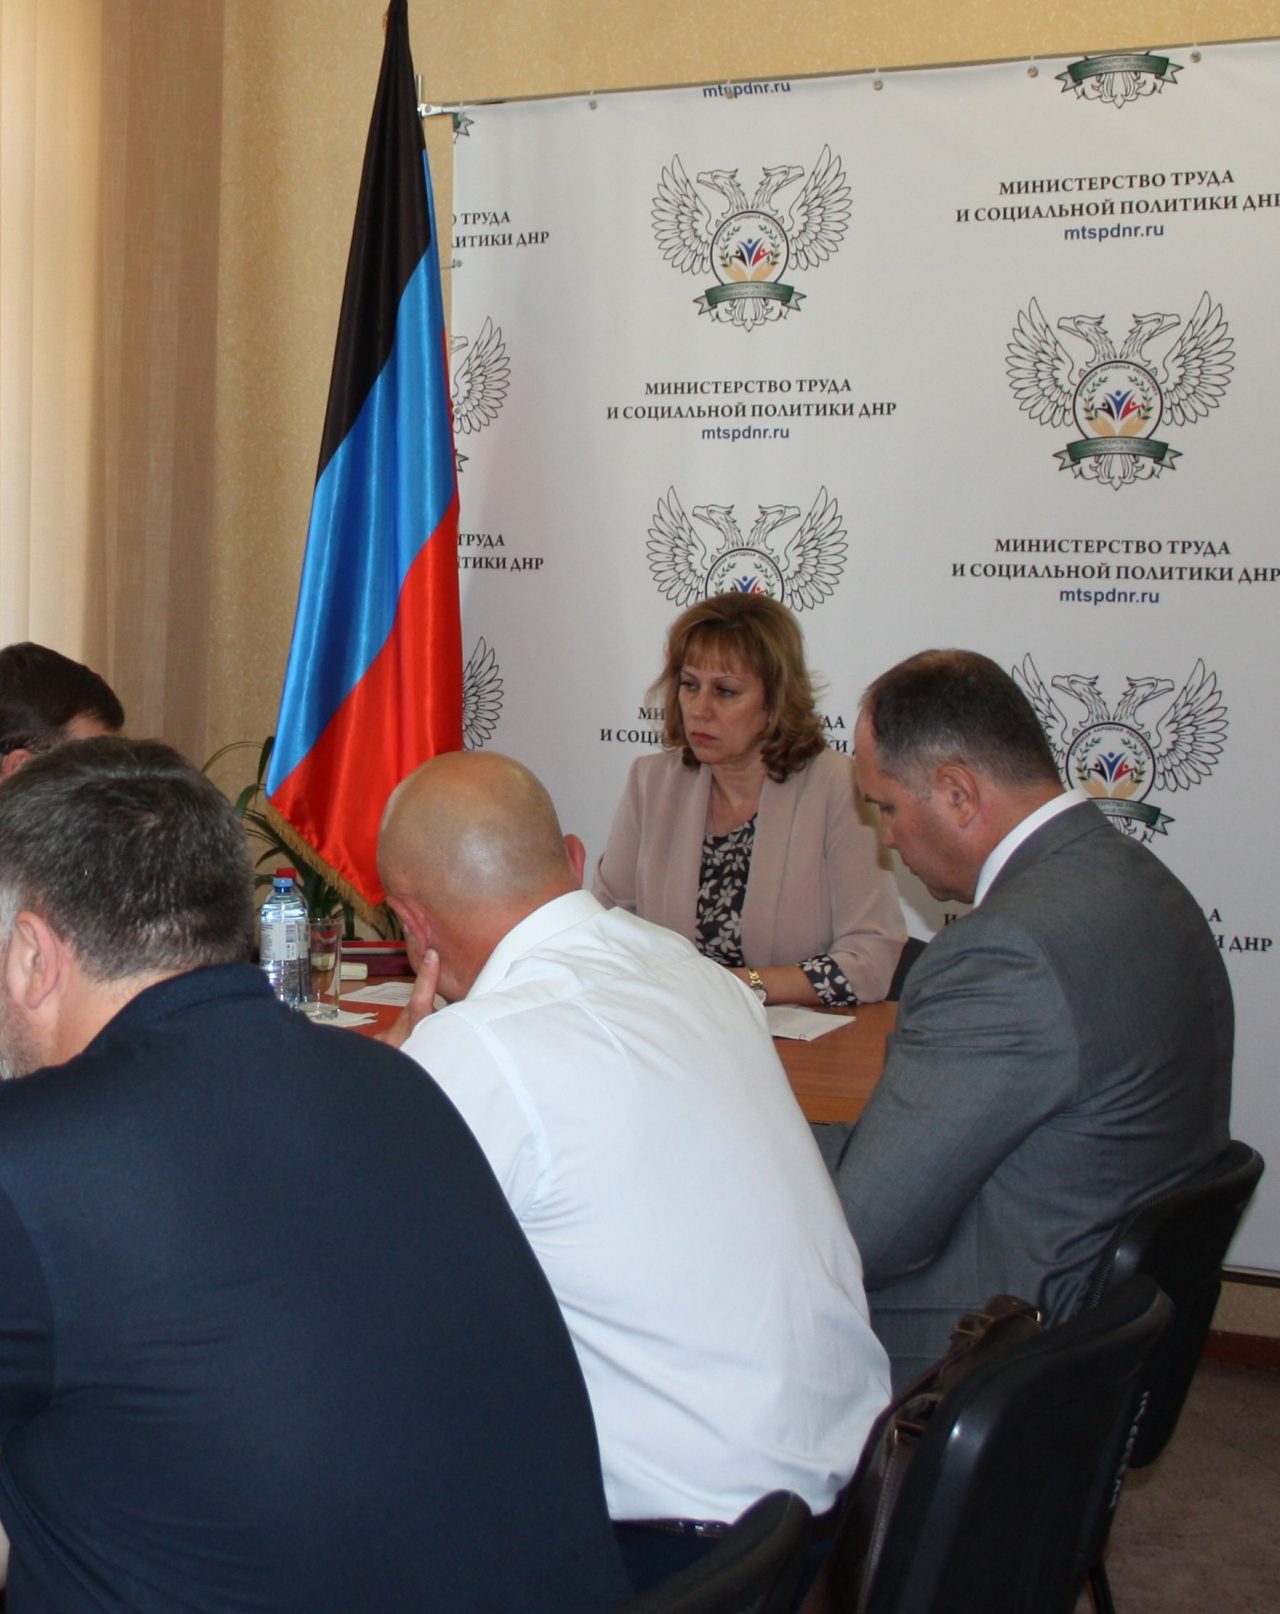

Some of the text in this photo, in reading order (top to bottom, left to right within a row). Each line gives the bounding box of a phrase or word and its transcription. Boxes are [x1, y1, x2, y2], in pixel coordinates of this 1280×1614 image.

[1000, 170, 1234, 195] МИНИСТЕРСТВО ТРУДА
[957, 209, 969, 222] И
[974, 199, 1115, 222] СОЦИАЛЬНОЙ
[1120, 196, 1237, 214] ПОЛИТИКИ
[461, 211, 510, 225] ТРУДА
[452, 232, 549, 249] ИТИКИ ДНР
[1064, 223, 1164, 242] mtspdnr.ru
[645, 379, 851, 395] МИНИСТЕРСТВО ТРУДА
[607, 402, 896, 421] И СОЦИАЛЬНОЙ ПОЛИТИКИ ДНР
[702, 425, 789, 442] mtspdnr.ru
[995, 539, 1231, 557] МИНИСТЕРСТВО ТРУДА
[458, 556, 543, 572] ТИКИ ДНР
[952, 563, 1280, 584] И СОЦИАЛЬНОЙ ПОЛИТИКИ ДНР
[1060, 588, 1159, 606] mtspdnr.ru
[600, 729, 612, 741] И
[1229, 936, 1272, 952] ДНР
